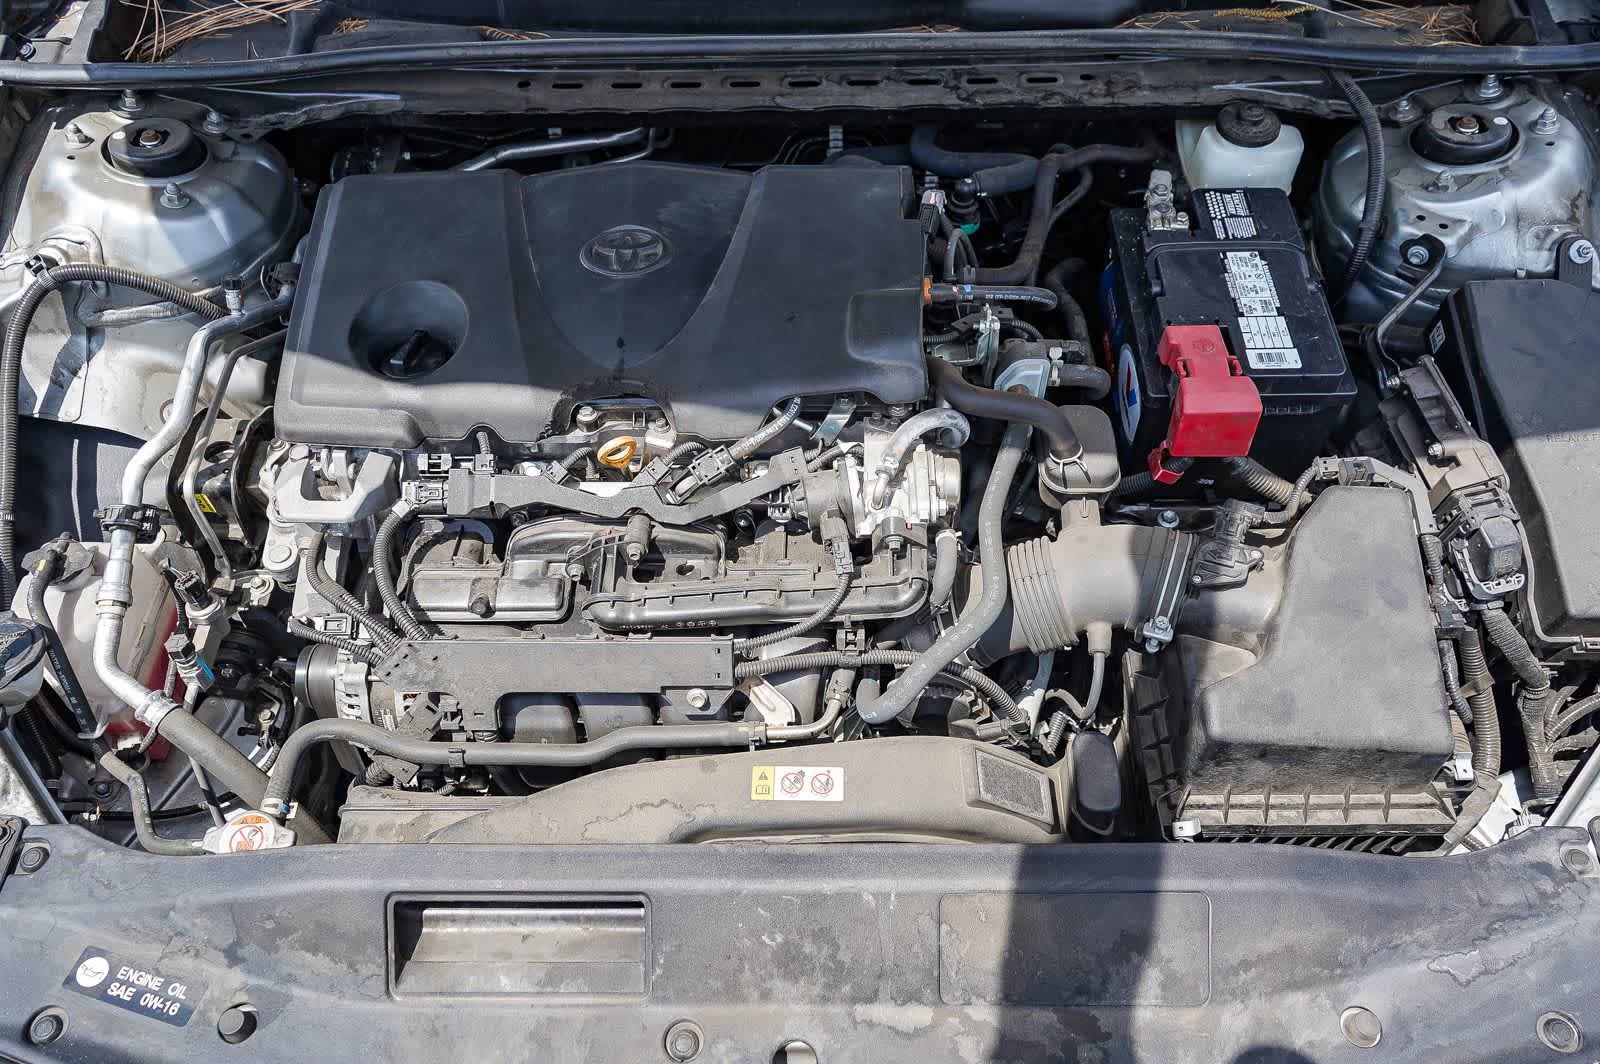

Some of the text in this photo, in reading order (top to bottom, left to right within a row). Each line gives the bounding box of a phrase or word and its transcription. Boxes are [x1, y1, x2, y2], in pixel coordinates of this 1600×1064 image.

[107, 982, 181, 1016] SAE 0W-16
[117, 966, 187, 1000] ENGINE OIL
